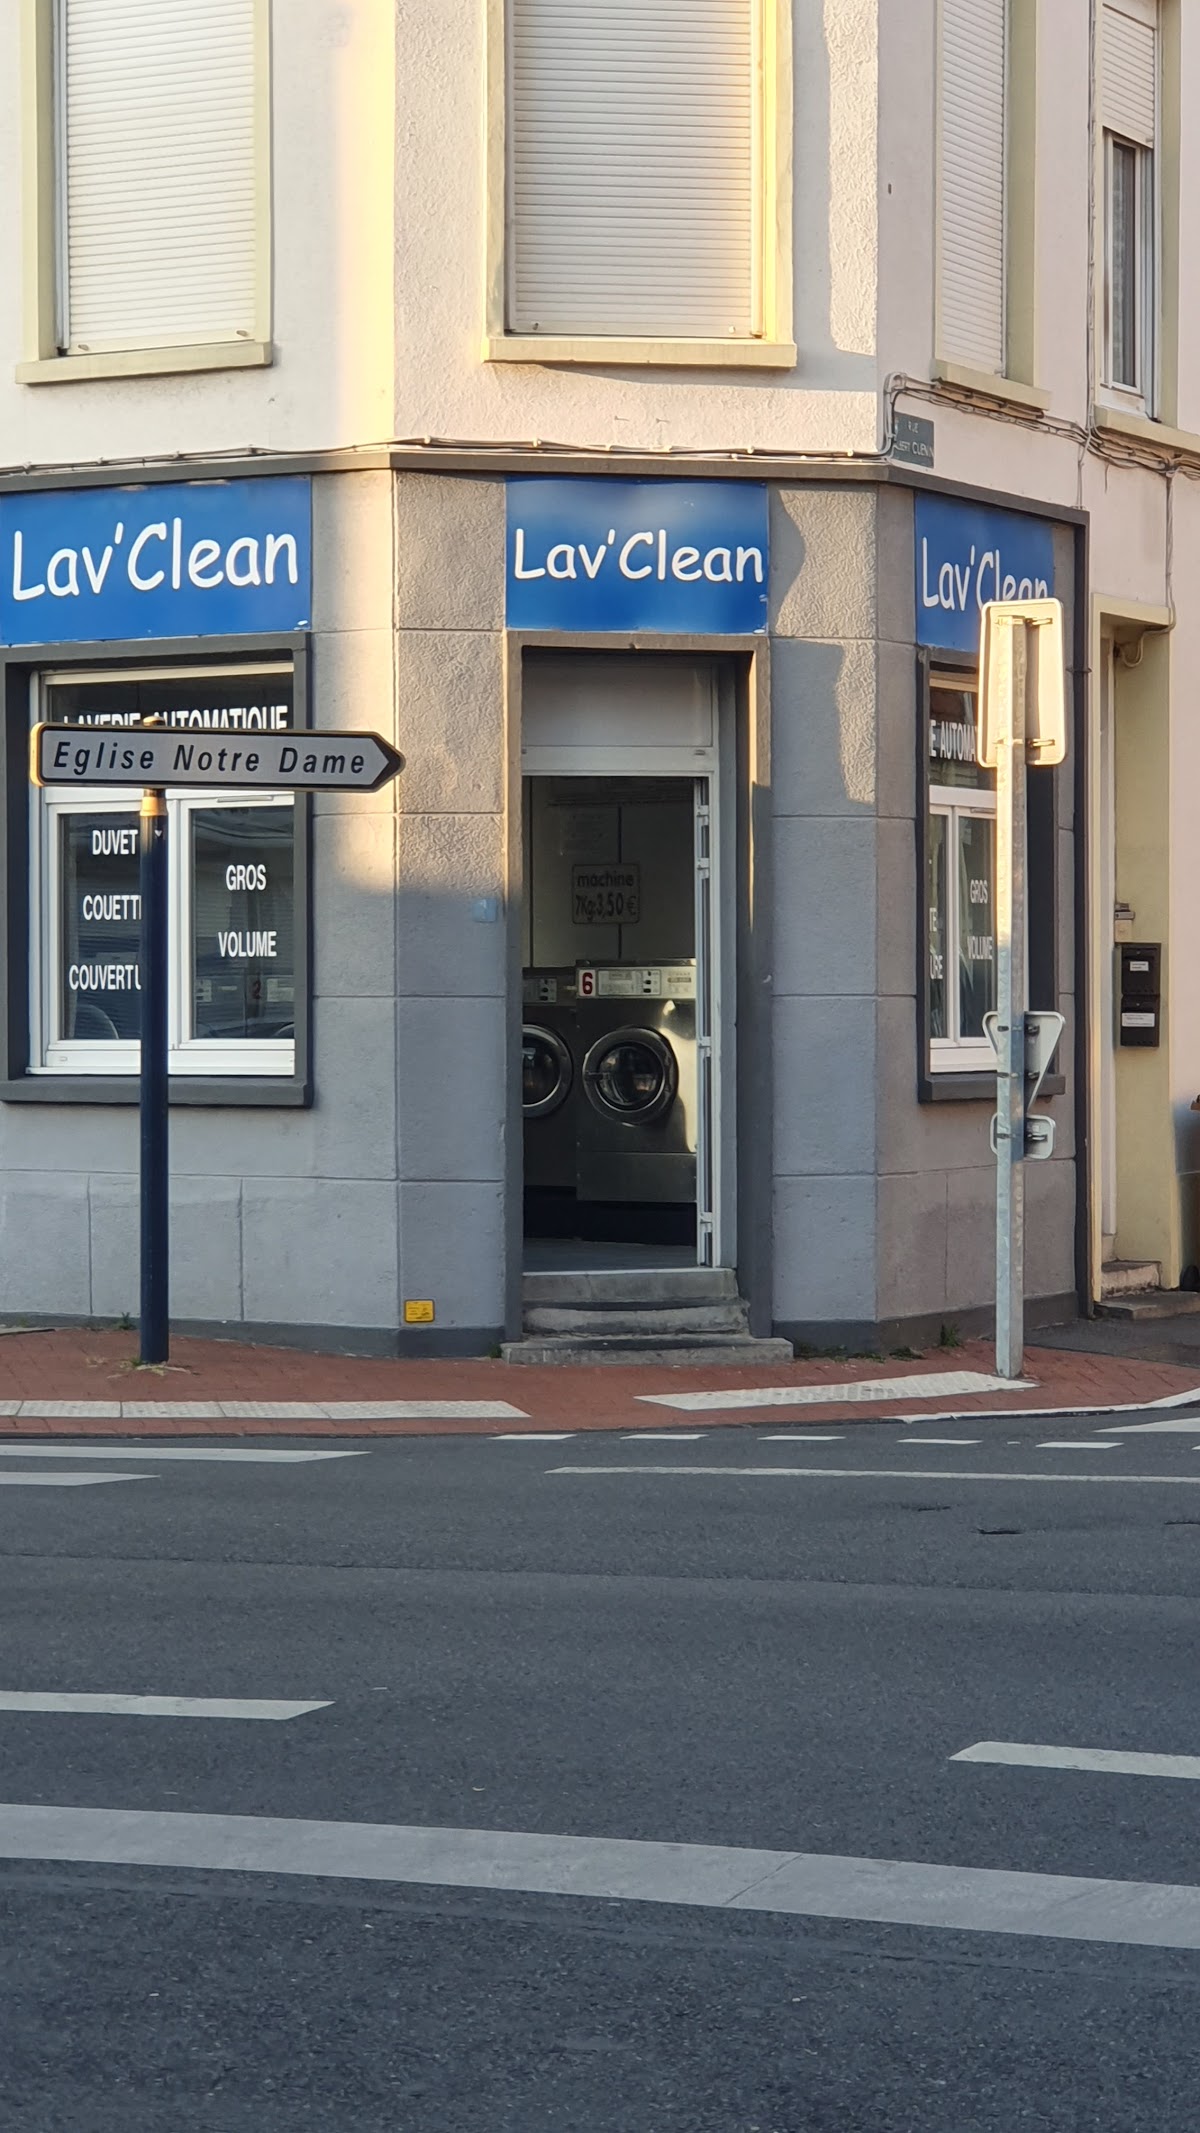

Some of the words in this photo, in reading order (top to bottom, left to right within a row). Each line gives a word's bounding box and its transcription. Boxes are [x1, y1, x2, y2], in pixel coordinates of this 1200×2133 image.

[12, 517, 299, 601] Lav'Clean
[514, 528, 763, 583] Lav'Clean
[940, 720, 978, 762] AUTOMA
[53, 741, 154, 775] Eglise
[173, 743, 260, 772] Notre
[278, 746, 365, 774] Dame
[92, 829, 138, 855] DUVET
[225, 864, 267, 891] GROS
[970, 879, 988, 904] GROS
[218, 931, 277, 957] VOLUME
[967, 935, 993, 960] VOLUME
[68, 964, 142, 990] COUVERTU
[581, 972, 594, 995] 6
